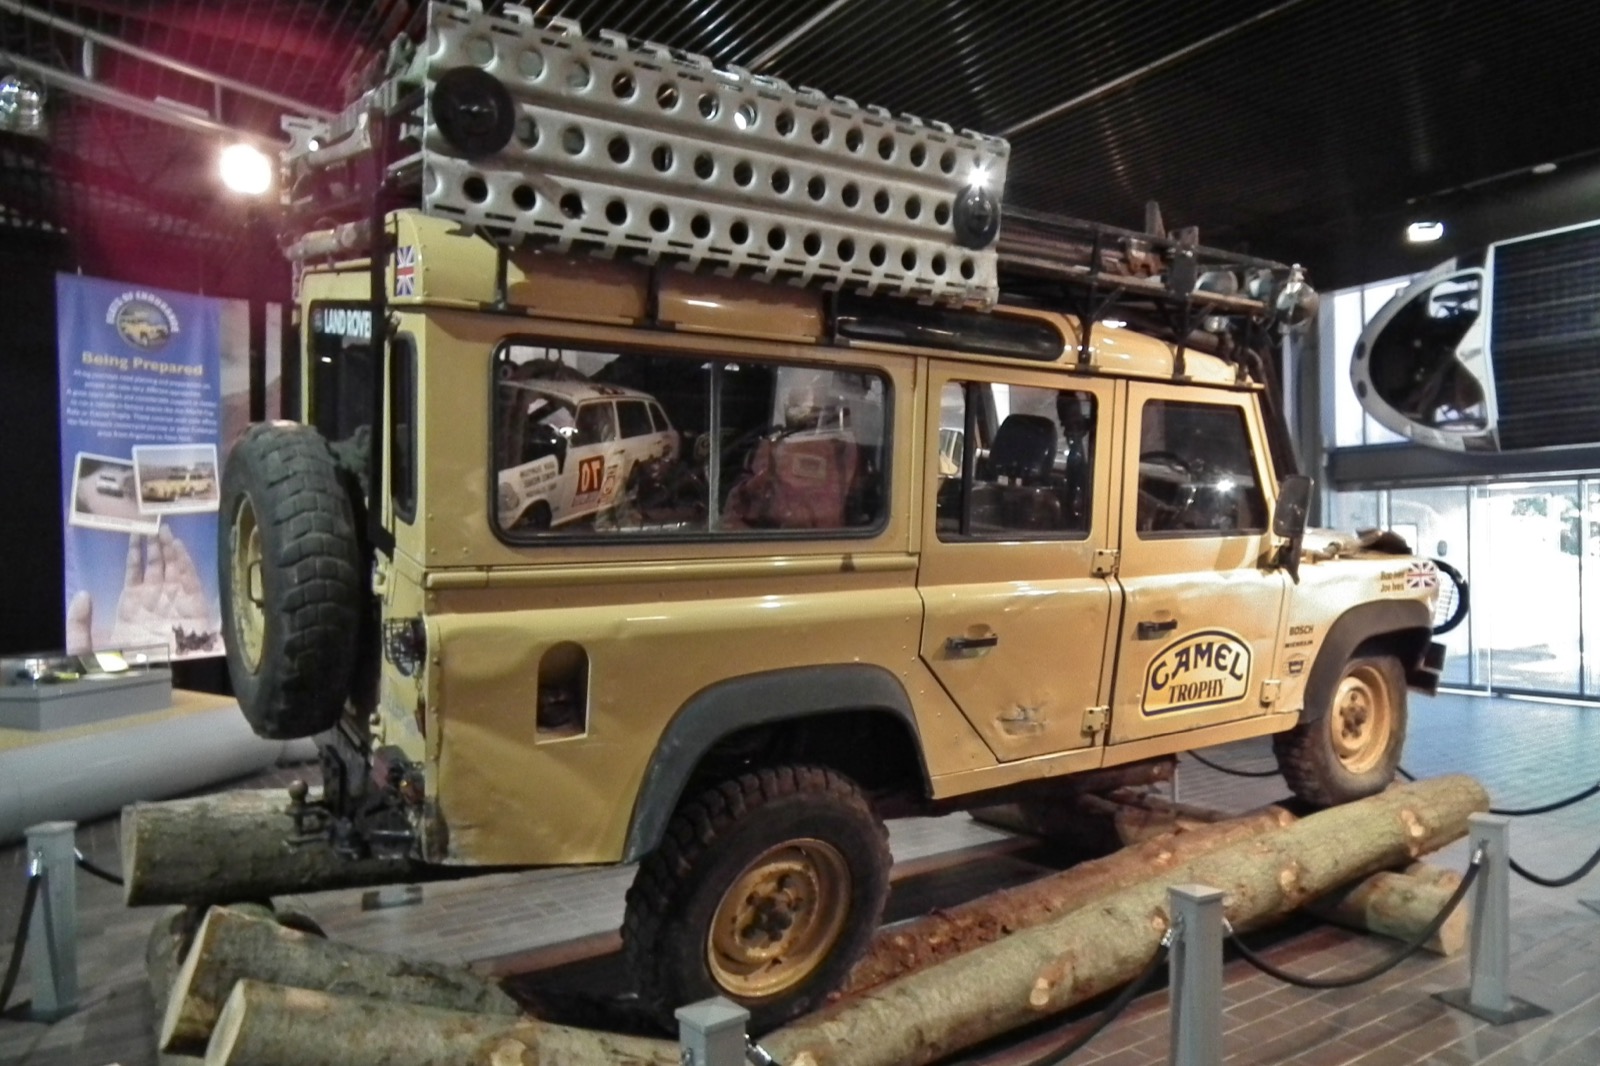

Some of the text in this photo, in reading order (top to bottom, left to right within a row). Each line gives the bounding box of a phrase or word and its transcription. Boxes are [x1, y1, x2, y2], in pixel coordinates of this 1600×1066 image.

[324, 308, 372, 338] LAND ROVE
[82, 350, 203, 376] Being Prepared
[1289, 625, 1314, 636] BOSCH
[1151, 642, 1244, 691] CAMEL
[1169, 678, 1226, 704] TROPHY
